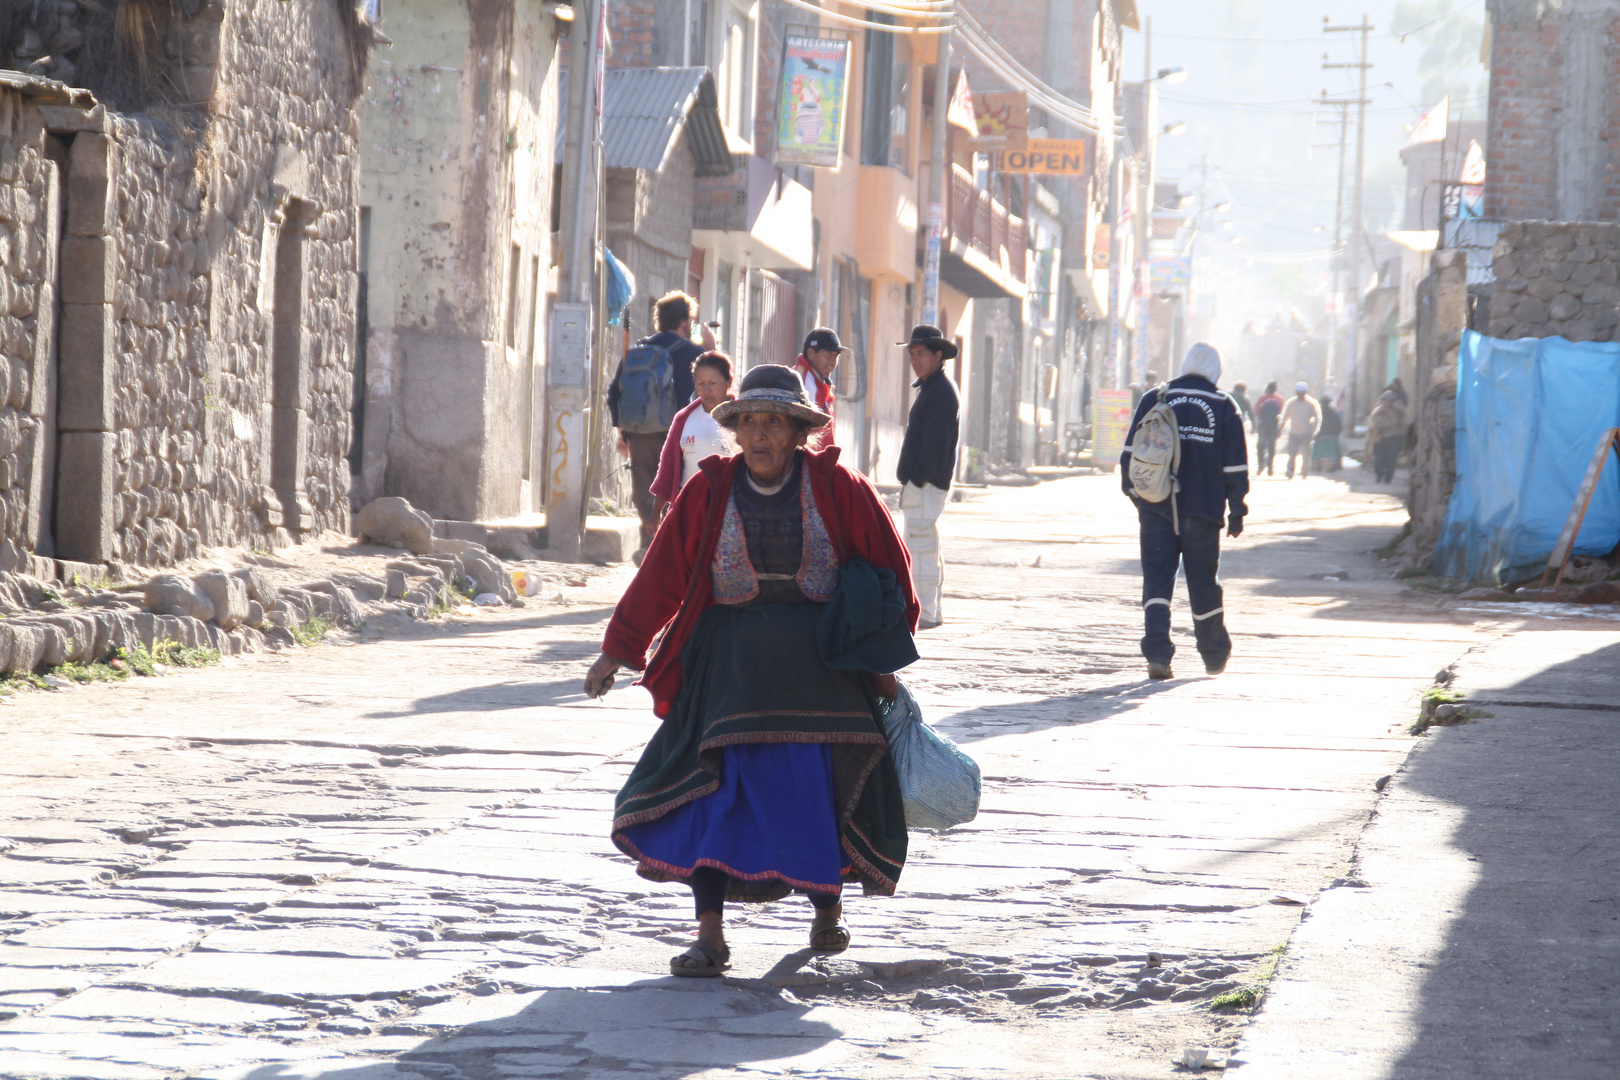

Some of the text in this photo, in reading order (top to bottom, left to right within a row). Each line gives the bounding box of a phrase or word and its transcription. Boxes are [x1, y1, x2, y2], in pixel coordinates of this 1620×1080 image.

[1008, 152, 1080, 170] OPEN
[1188, 397, 1216, 428] CARRETERA
[1187, 433, 1215, 443] CONDOR
